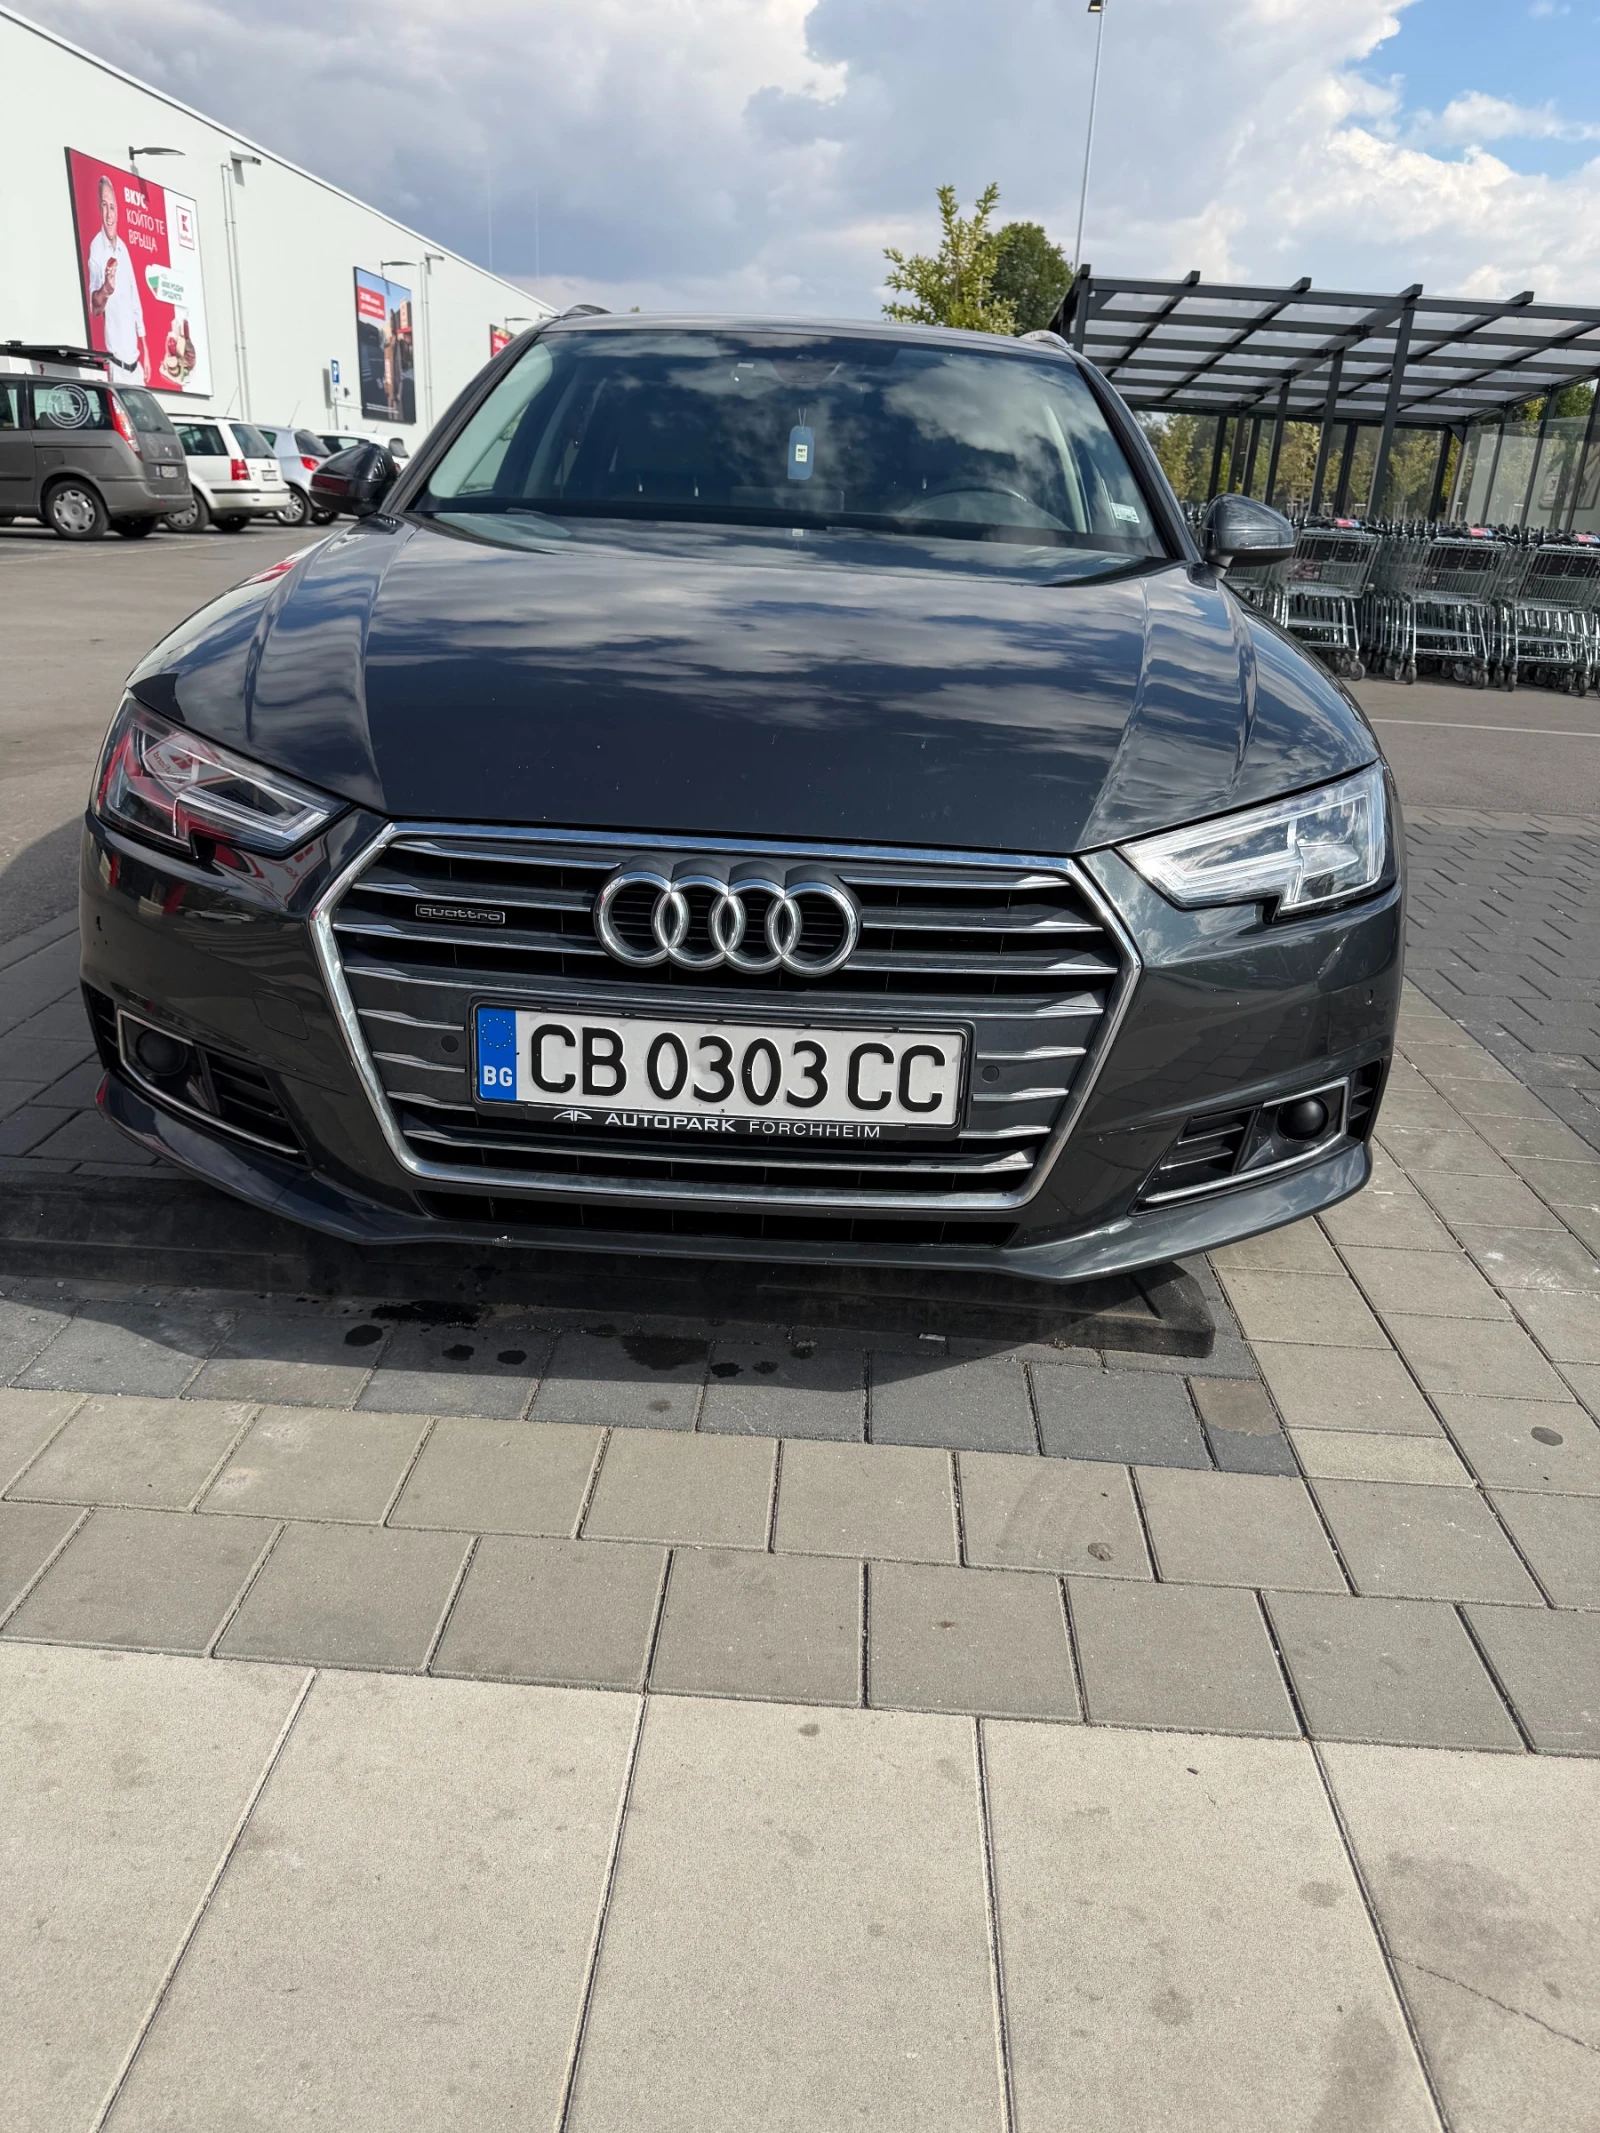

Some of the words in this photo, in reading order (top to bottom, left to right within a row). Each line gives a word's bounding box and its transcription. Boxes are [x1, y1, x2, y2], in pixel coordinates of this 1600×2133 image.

[124, 187, 148, 211] ВКУС,
[126, 208, 155, 232] КОЙТО
[154, 218, 166, 236] ТЕ
[128, 229, 158, 253] ВРЪЩА
[420, 907, 501, 921] quattro
[483, 1065, 513, 1087] BG
[531, 1023, 627, 1097] CB
[646, 1032, 829, 1108] 0303
[847, 1042, 946, 1113] CC
[604, 1113, 736, 1133] AUTOPARK
[749, 1122, 880, 1138] FORCHHEIM
